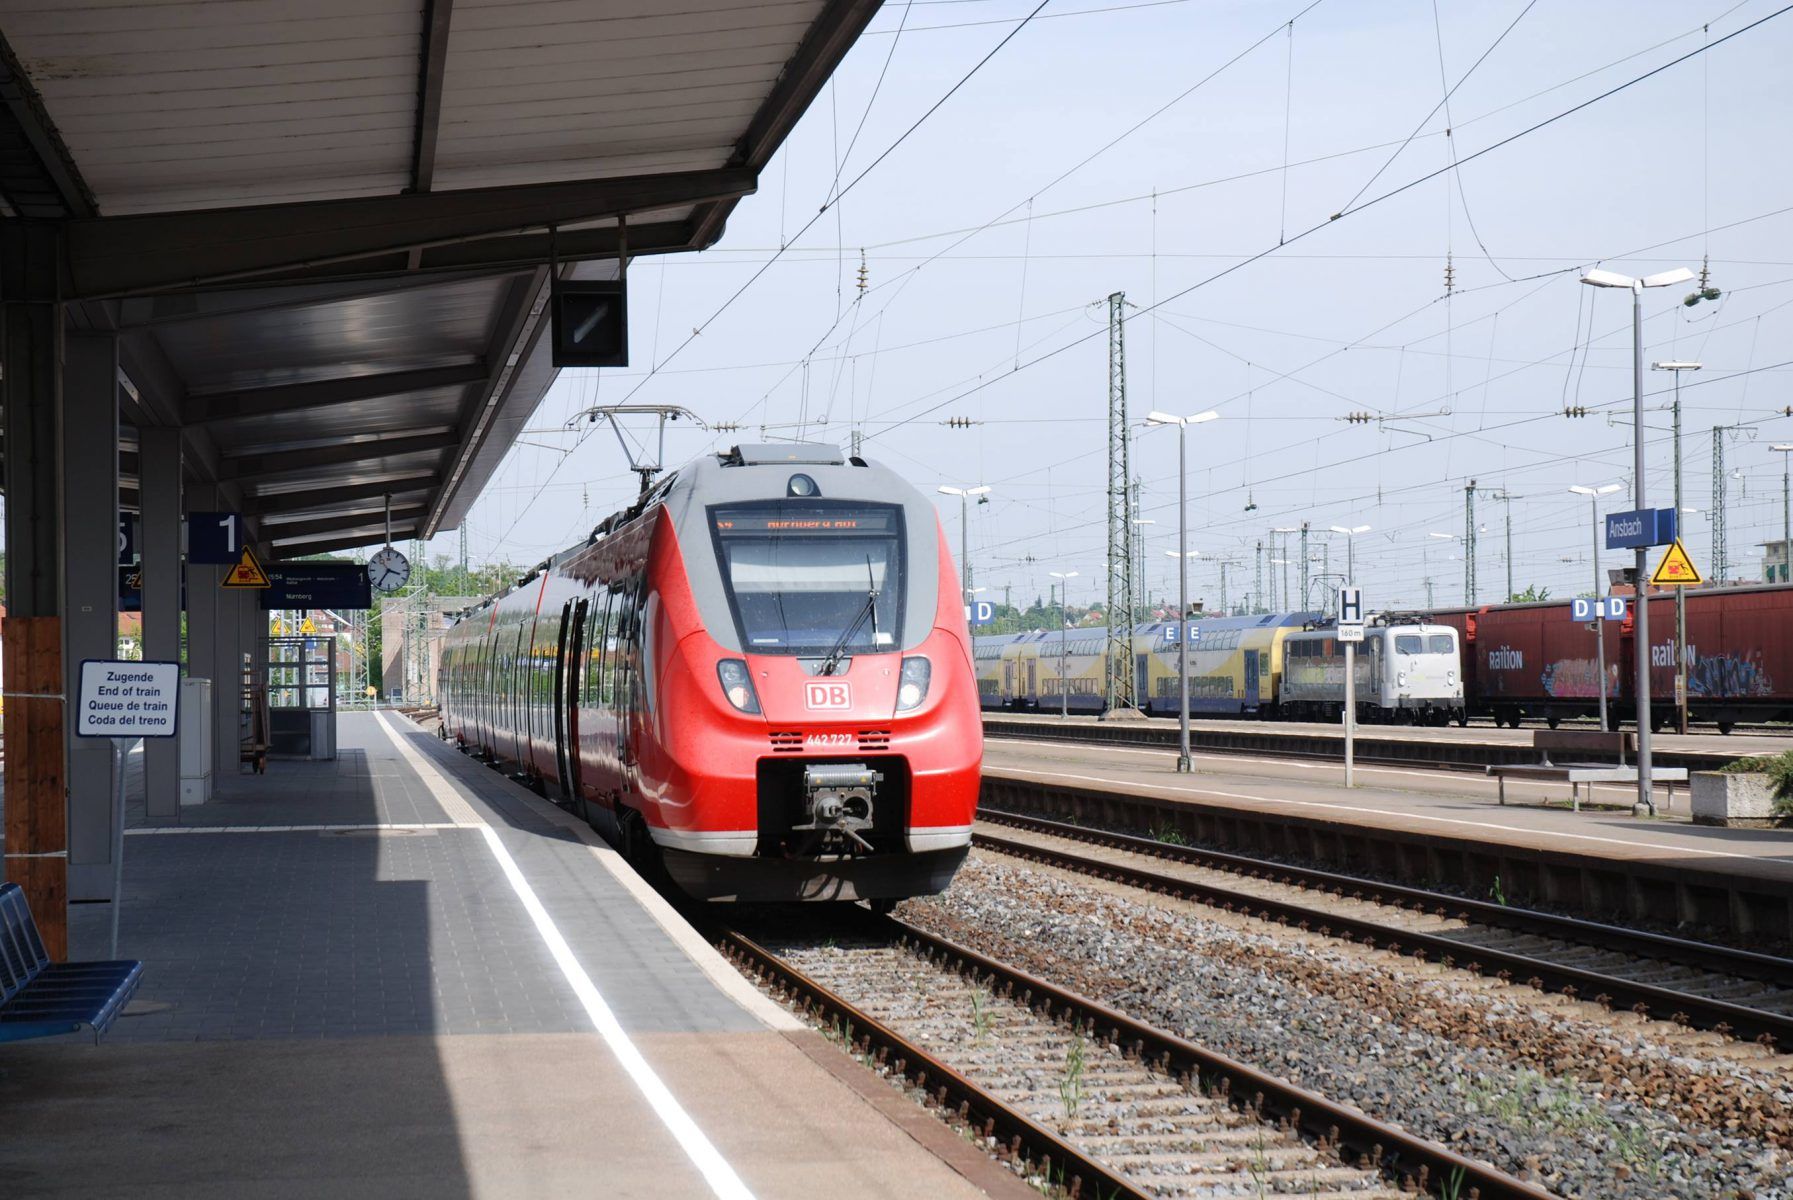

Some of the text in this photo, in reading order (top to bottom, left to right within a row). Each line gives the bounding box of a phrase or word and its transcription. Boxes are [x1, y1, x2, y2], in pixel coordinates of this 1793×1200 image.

[219, 514, 235, 552] 1
[1609, 517, 1642, 538] Ansbach
[978, 603, 991, 620] D
[1342, 590, 1360, 620] H
[1575, 599, 1588, 617] D
[1611, 598, 1625, 616] D
[1166, 627, 1174, 640] E
[1191, 627, 1199, 639] E
[106, 671, 154, 683] Zugende
[98, 685, 161, 697] End of train
[811, 687, 846, 705] DB
[88, 700, 168, 711] Queue de train
[88, 715, 167, 726] Coda del treno
[806, 734, 852, 745] 442 727
